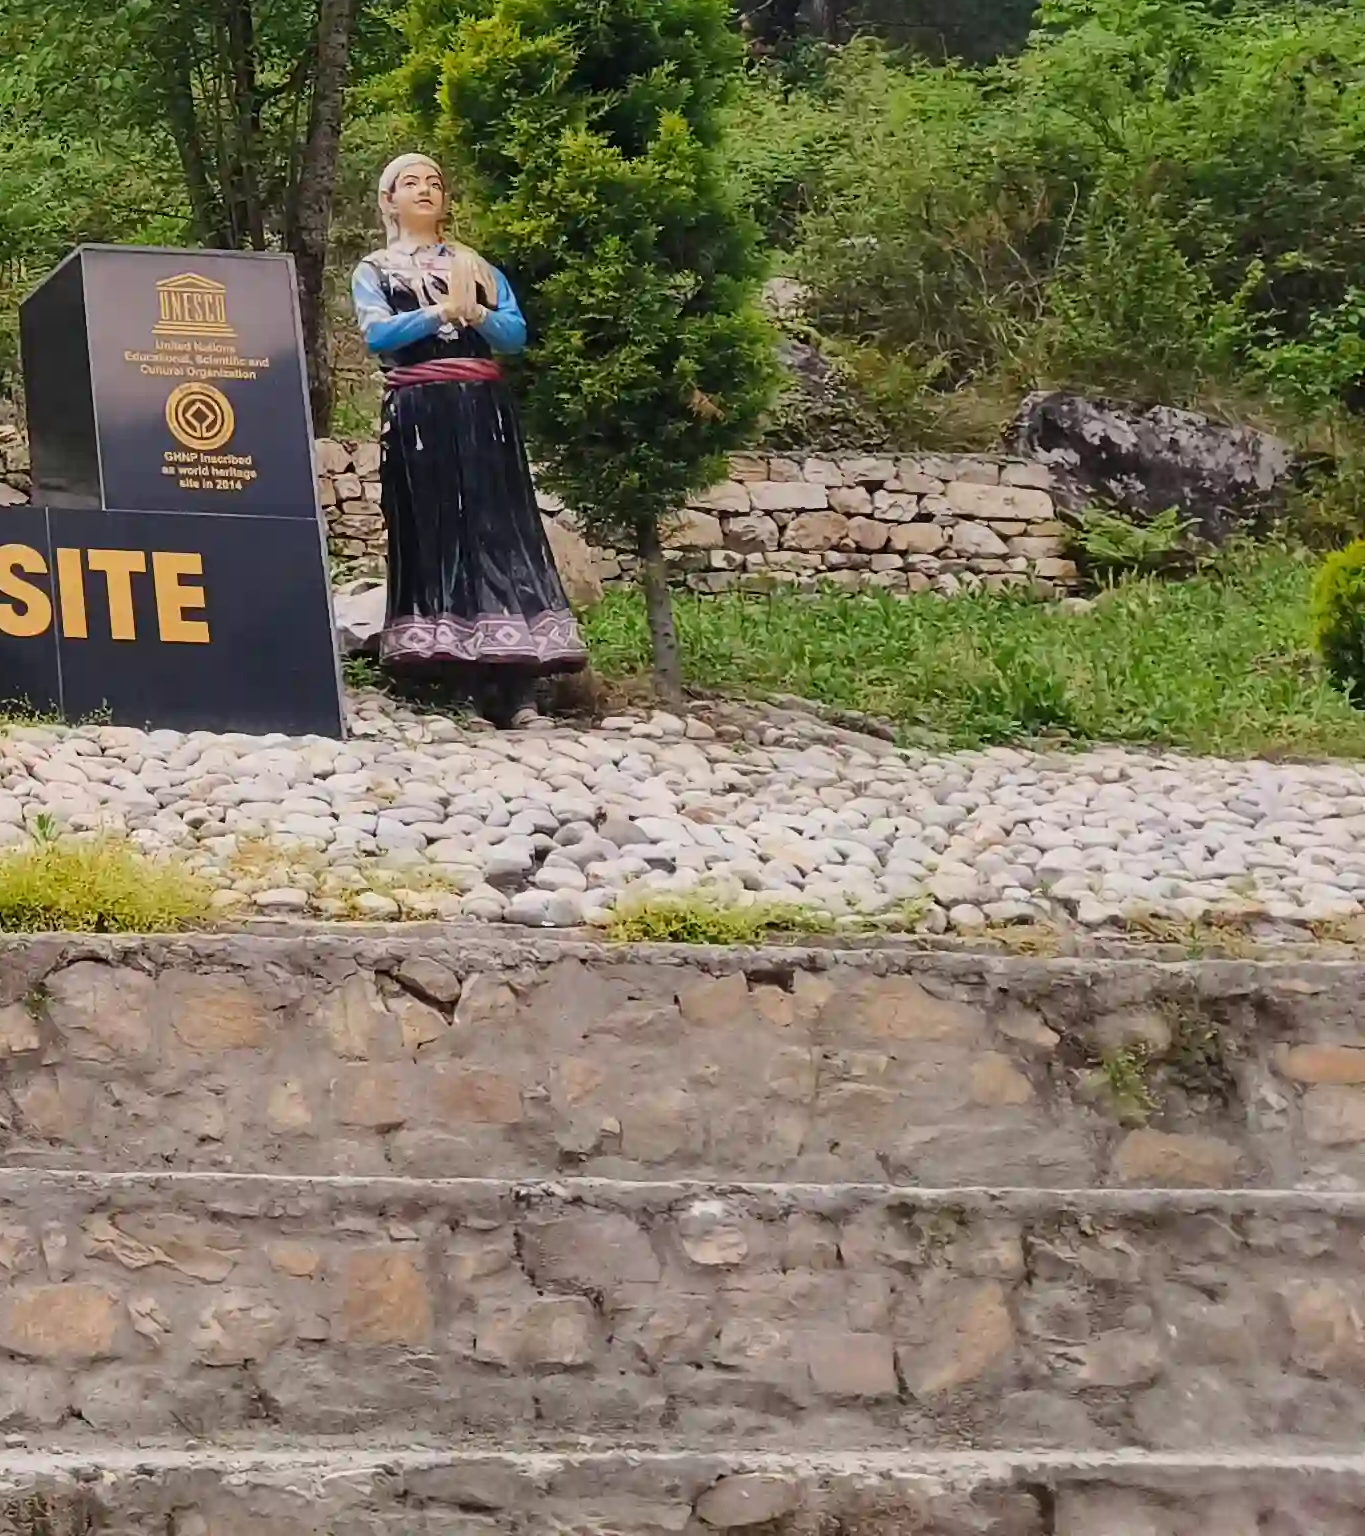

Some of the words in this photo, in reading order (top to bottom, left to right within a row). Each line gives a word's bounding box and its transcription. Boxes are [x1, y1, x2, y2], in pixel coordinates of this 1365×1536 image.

[160, 291, 226, 322] UNESCO
[155, 339, 191, 351] United
[194, 340, 236, 354] Nations
[248, 356, 269, 368] and
[140, 364, 184, 376] Cultural
[186, 366, 257, 380] Organization
[164, 451, 198, 463] GHNP
[161, 465, 176, 475] as
[177, 465, 209, 477] world
[211, 466, 258, 480] heritage
[179, 477, 199, 489] site
[202, 478, 213, 489] in
[215, 479, 243, 491] 2014
